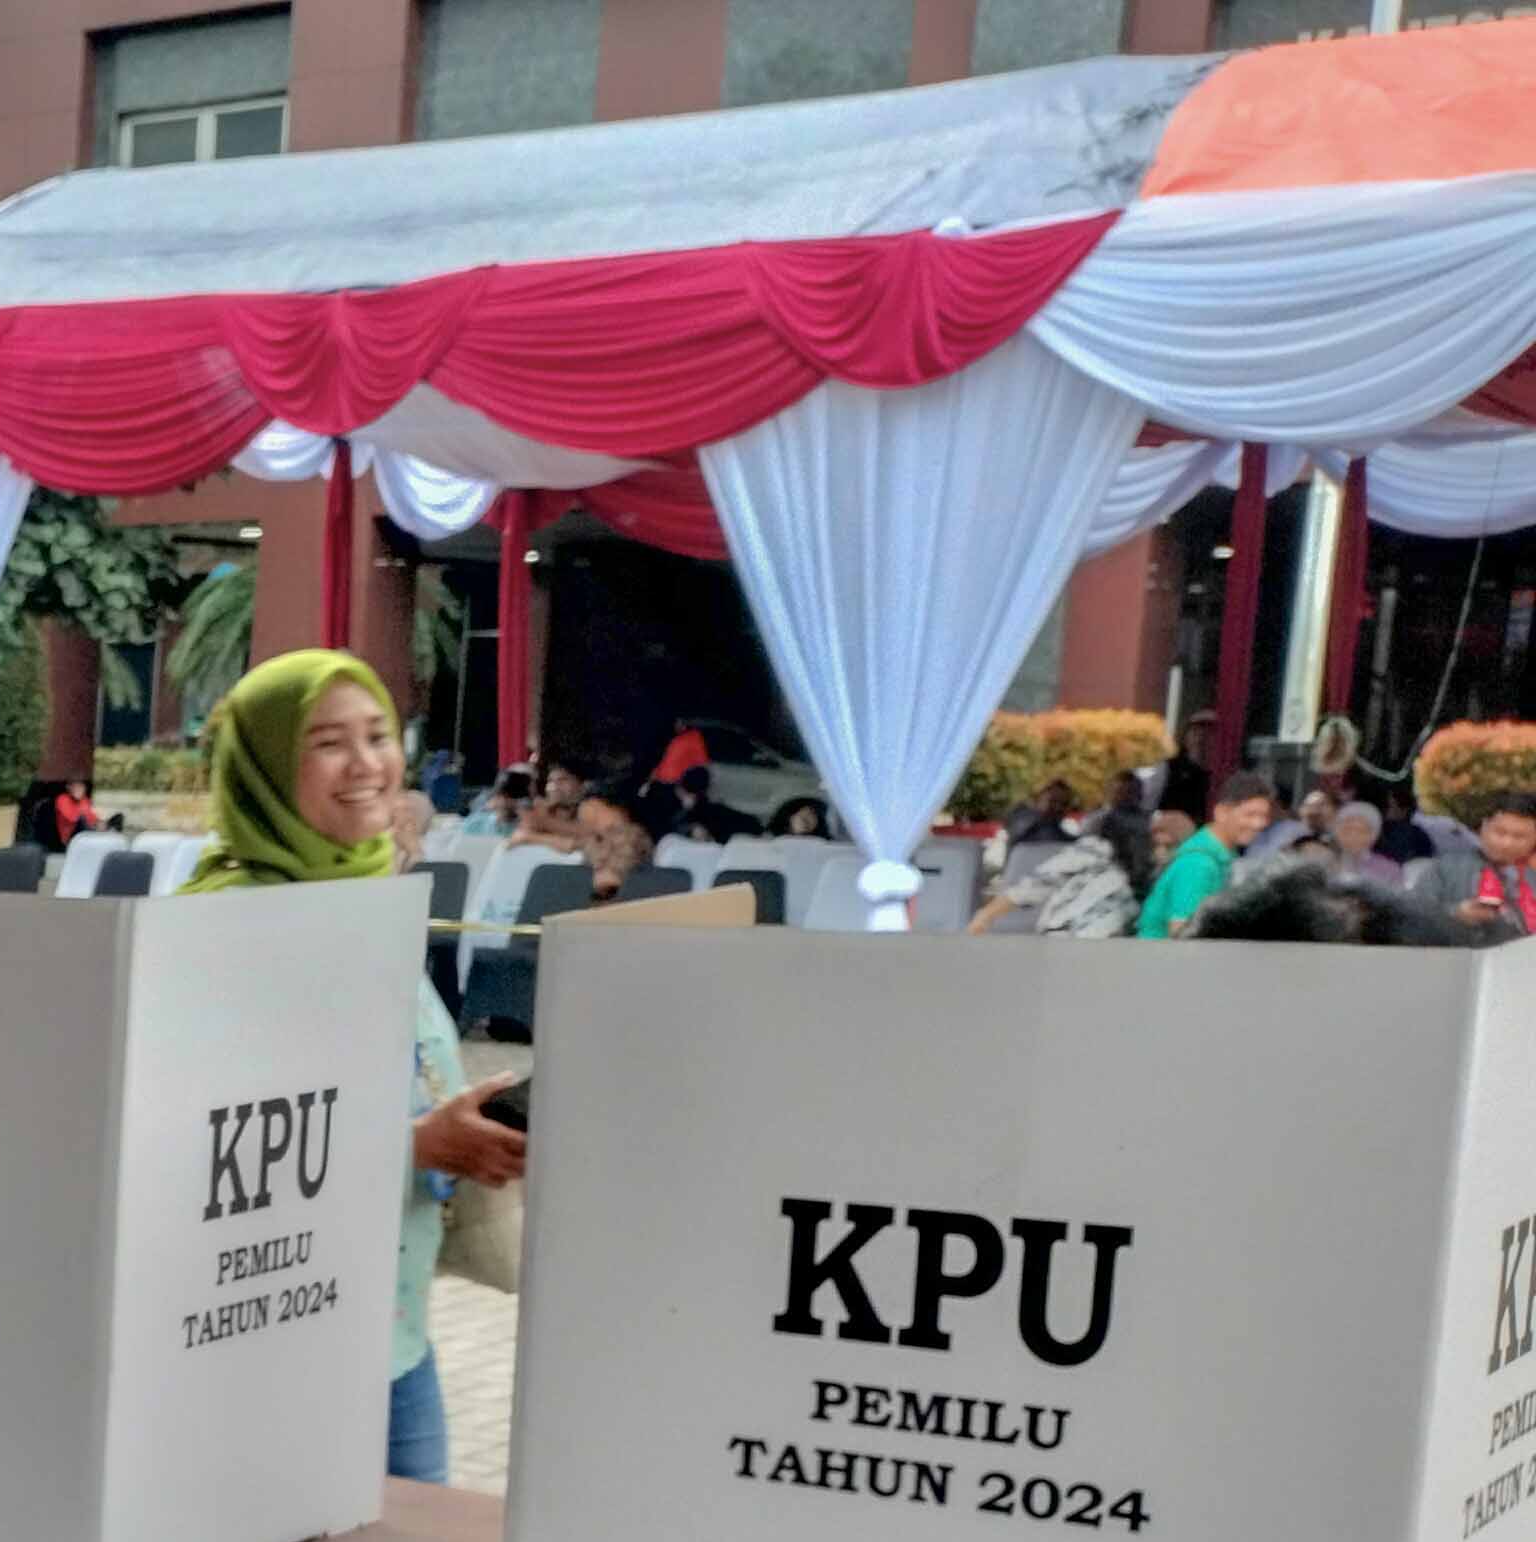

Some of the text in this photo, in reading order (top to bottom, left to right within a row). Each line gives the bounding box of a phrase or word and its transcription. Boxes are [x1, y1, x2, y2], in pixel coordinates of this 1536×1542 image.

[202, 1087, 339, 1222] KPU
[216, 1231, 314, 1286] PEMILU
[771, 1196, 1135, 1368] KPU
[182, 1277, 339, 1349] TAHUN 2024
[810, 1379, 1070, 1450] PEMILU
[1488, 1390, 1536, 1456] PEMI
[728, 1436, 1151, 1533] TAHUN 2024
[1463, 1463, 1524, 1540] TAHUN
